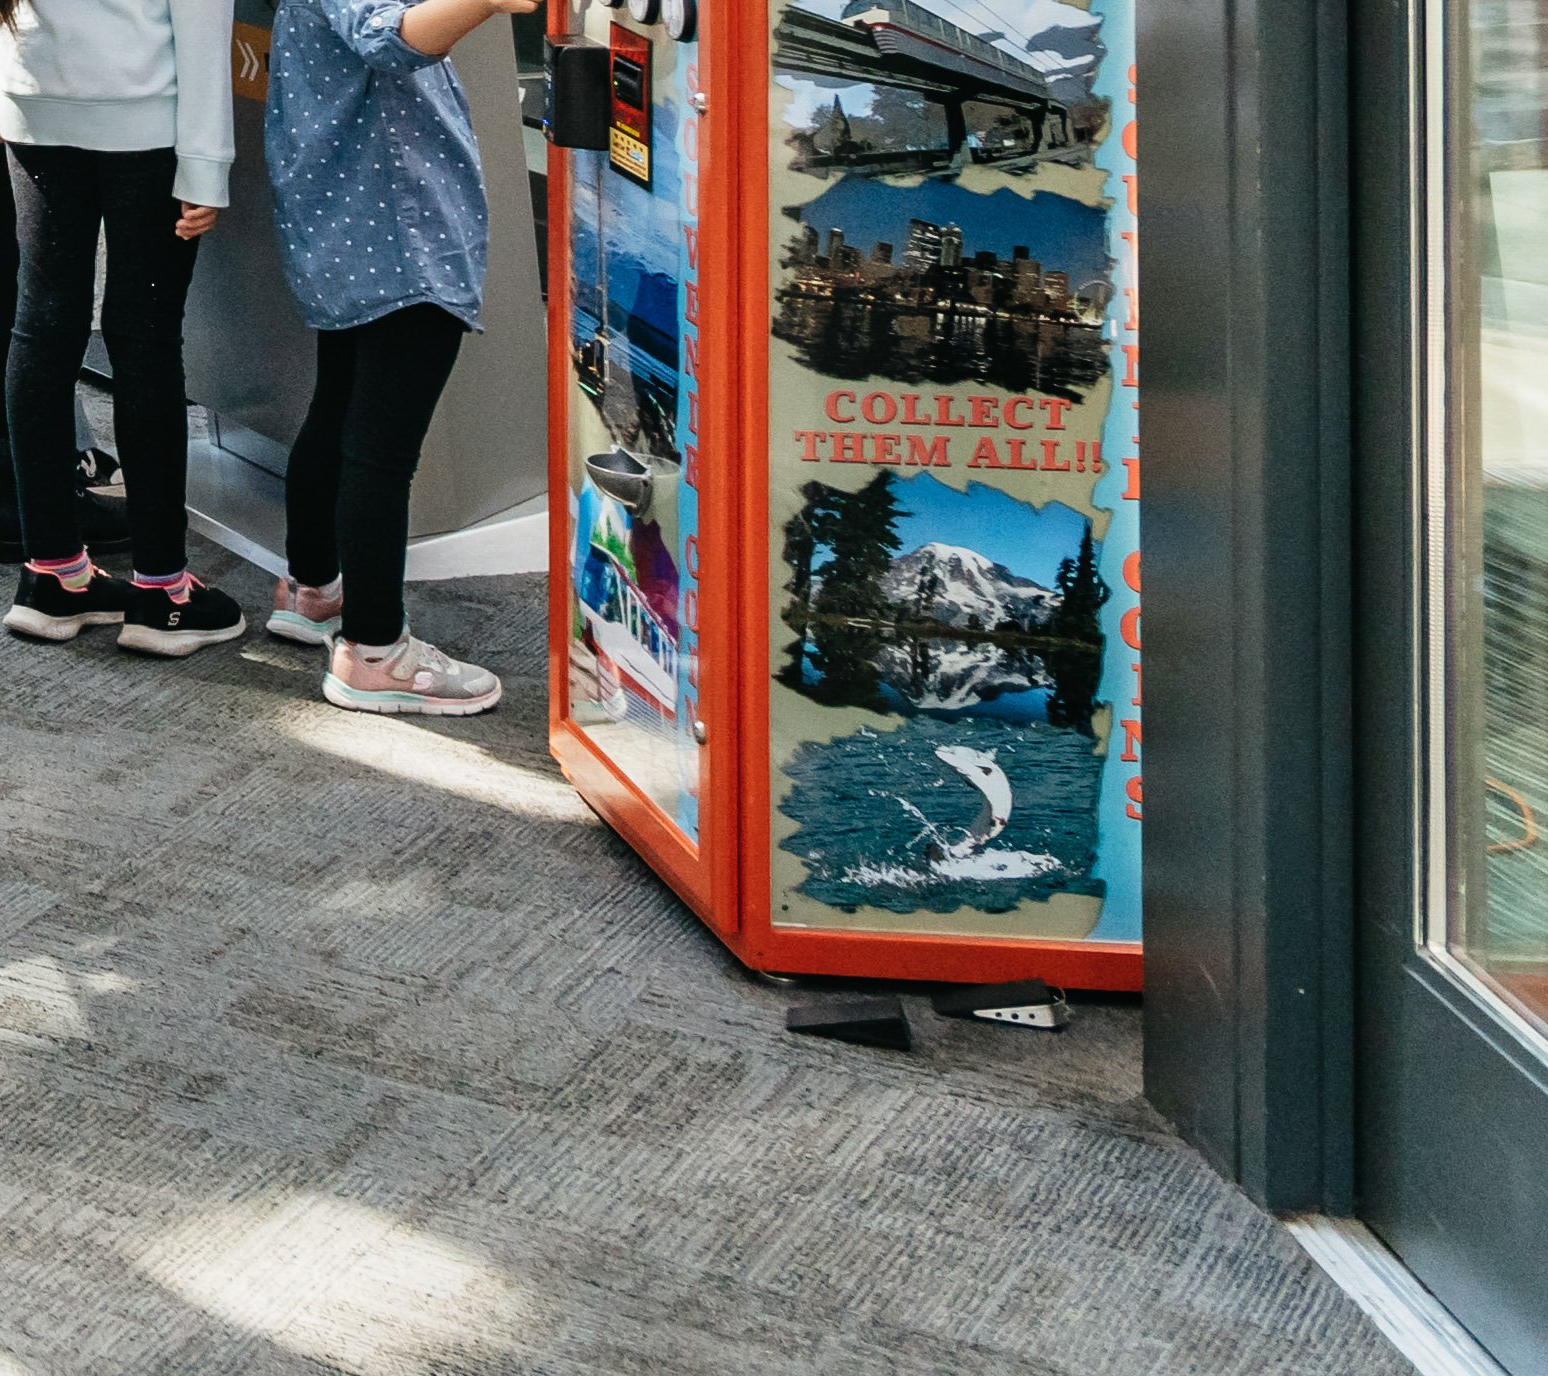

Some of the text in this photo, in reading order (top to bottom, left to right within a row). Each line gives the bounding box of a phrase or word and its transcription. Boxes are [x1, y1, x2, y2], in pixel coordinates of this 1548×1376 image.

[824, 389, 1072, 430] COLLECT
[794, 430, 1102, 474] THEM ALL!!
